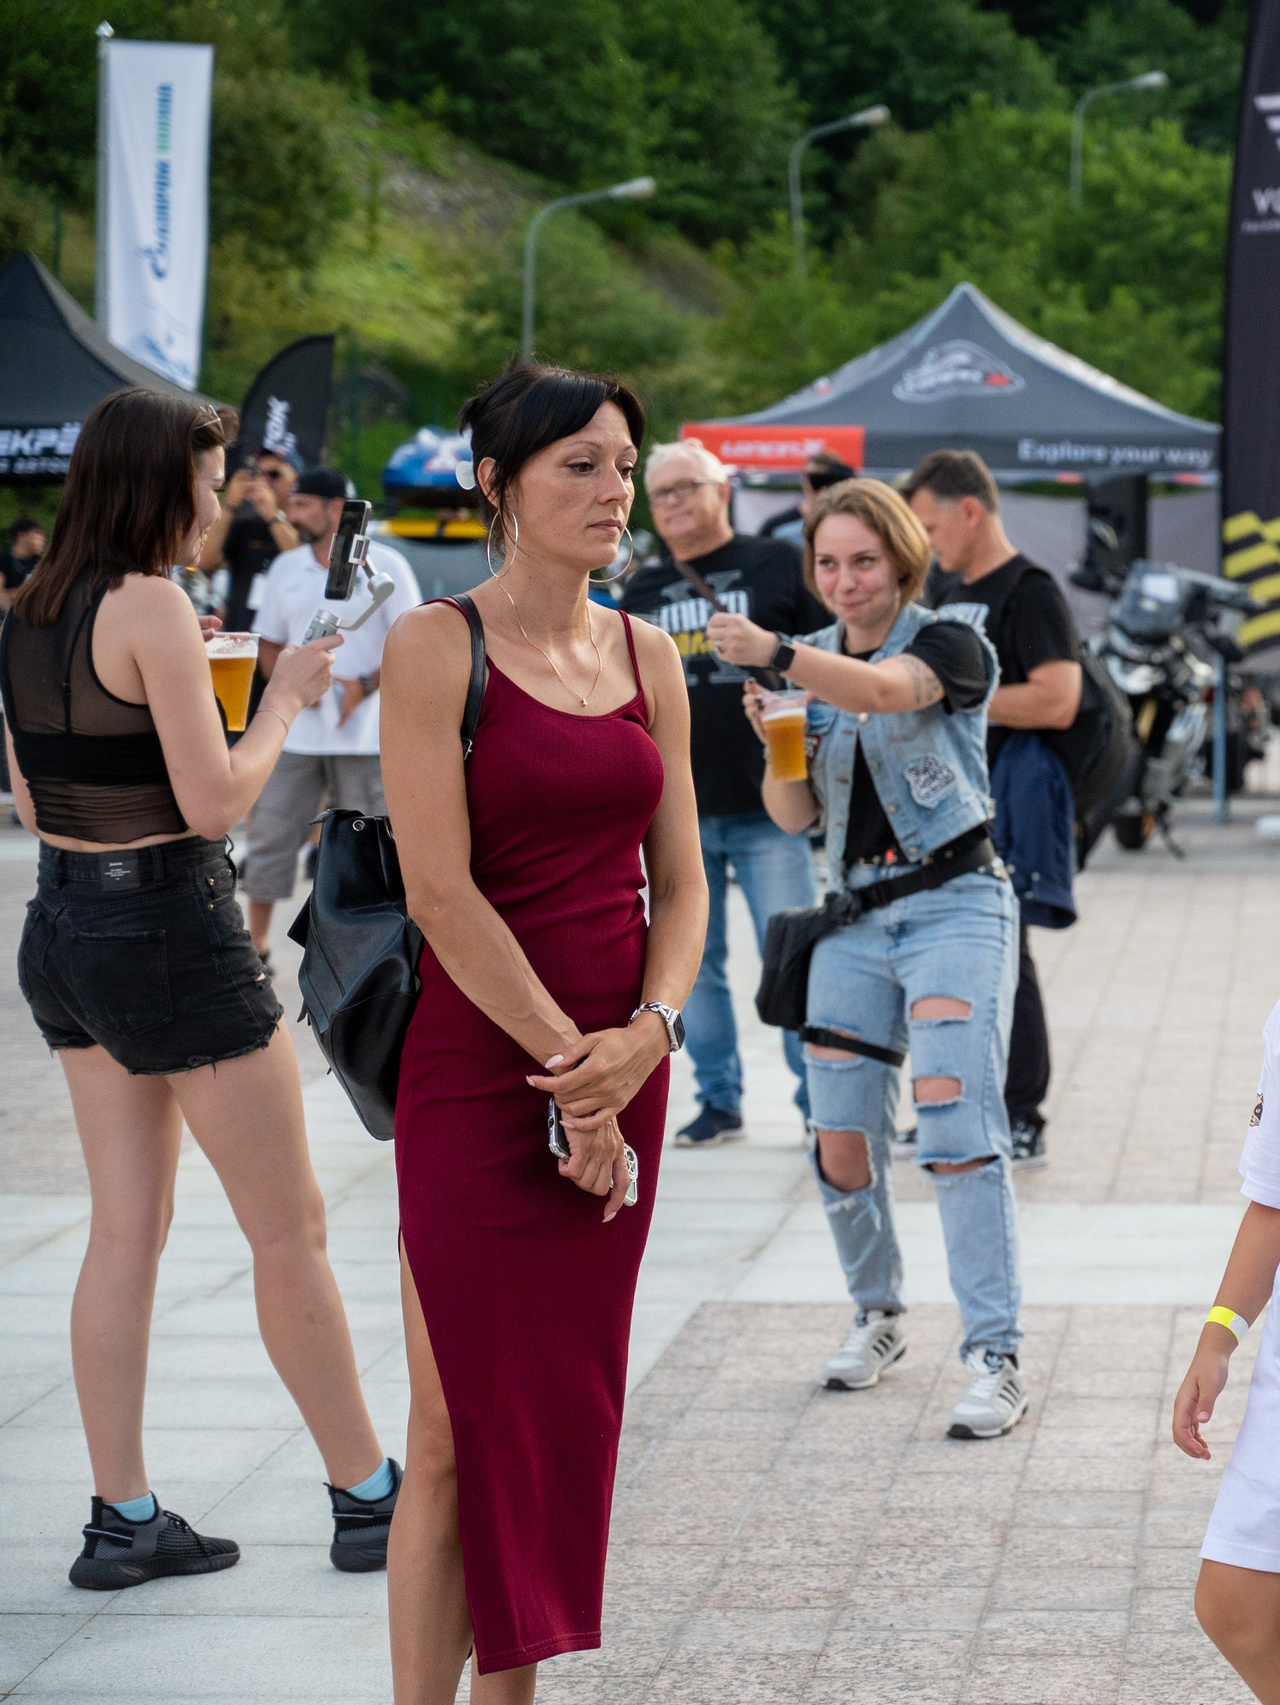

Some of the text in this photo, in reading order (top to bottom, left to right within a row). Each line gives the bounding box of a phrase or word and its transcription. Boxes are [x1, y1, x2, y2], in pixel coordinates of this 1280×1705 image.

[1017, 438, 1214, 469] Explore your way
